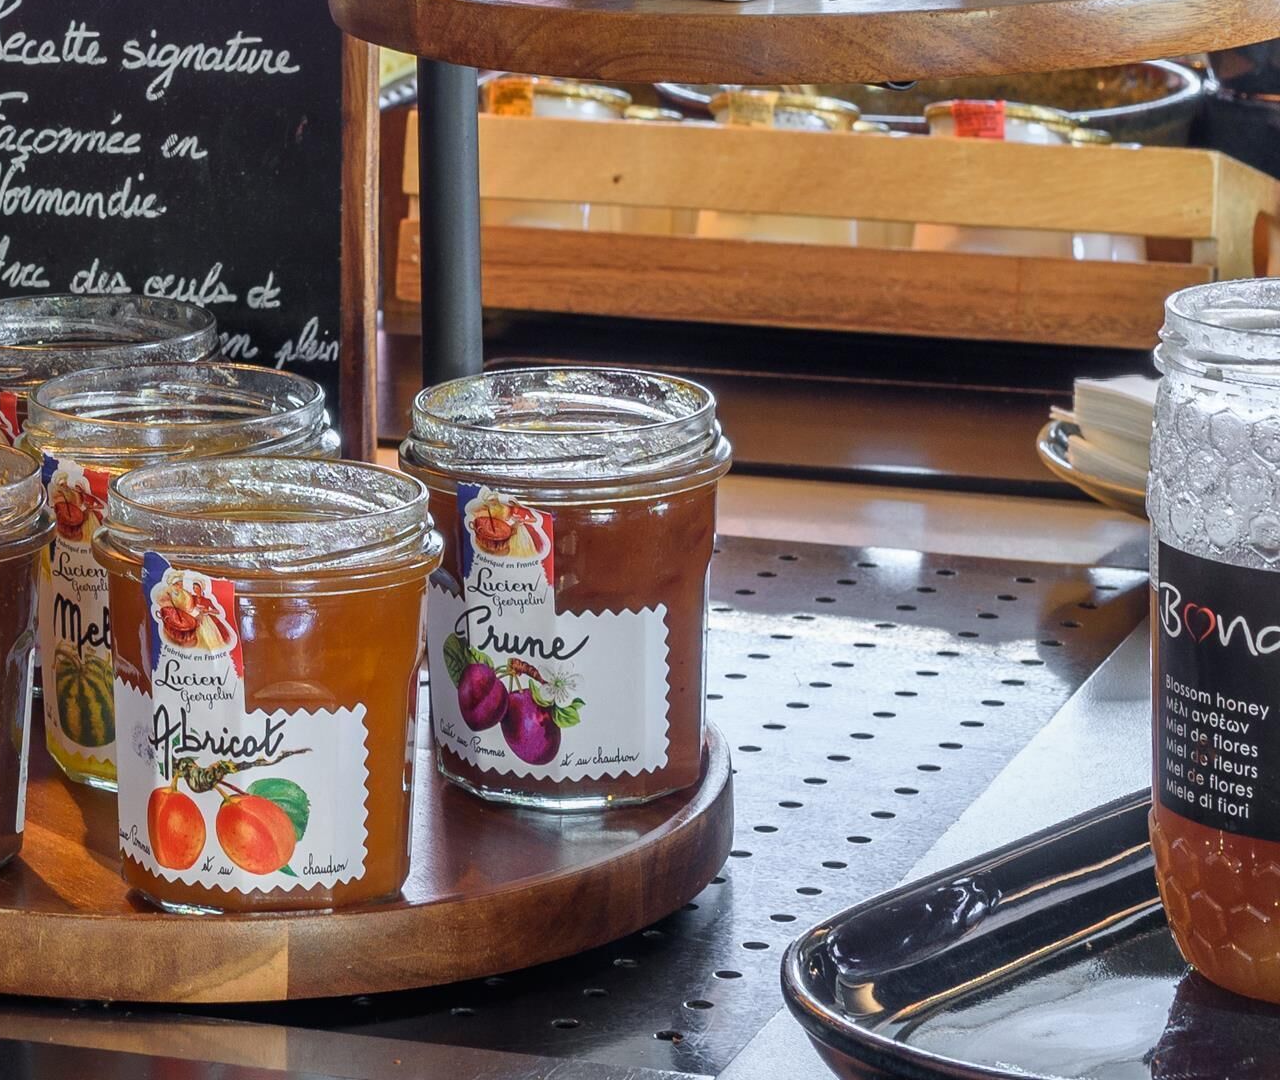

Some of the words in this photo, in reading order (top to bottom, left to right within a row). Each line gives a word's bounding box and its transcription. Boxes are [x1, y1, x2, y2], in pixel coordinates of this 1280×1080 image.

[121, 29, 301, 101] signature
[161, 133, 208, 159] en
[69, 257, 132, 295] des
[274, 315, 340, 370] plein
[52, 551, 109, 581] Lucien
[467, 567, 542, 597] Lucien
[71, 579, 109, 602] Georgeli
[492, 587, 548, 617] Georgelin
[52, 592, 112, 661] Mel
[454, 605, 590, 660] Prune
[154, 659, 230, 691] Lucien
[181, 682, 237, 713] Georgelin
[1165, 673, 1211, 705] Blossom
[1216, 691, 1269, 720] honey
[148, 704, 286, 781] Abricot
[469, 735, 506, 757] Pommes
[560, 752, 574, 767] et
[592, 746, 640, 764] chaudron
[1166, 717, 1187, 738] Miel
[1191, 728, 1208, 745] de
[1213, 733, 1259, 758] flores
[1166, 738, 1187, 758] Miel
[1191, 748, 1208, 766] de
[1213, 754, 1259, 778] fleurs
[1166, 758, 1184, 778] Mel
[1188, 768, 1205, 785] de
[1209, 774, 1254, 798] flores
[1166, 778, 1195, 803] Miele
[1199, 793, 1213, 809] di
[1217, 797, 1249, 818] fiori
[201, 855, 215, 873] et
[302, 852, 349, 879] chaudron
